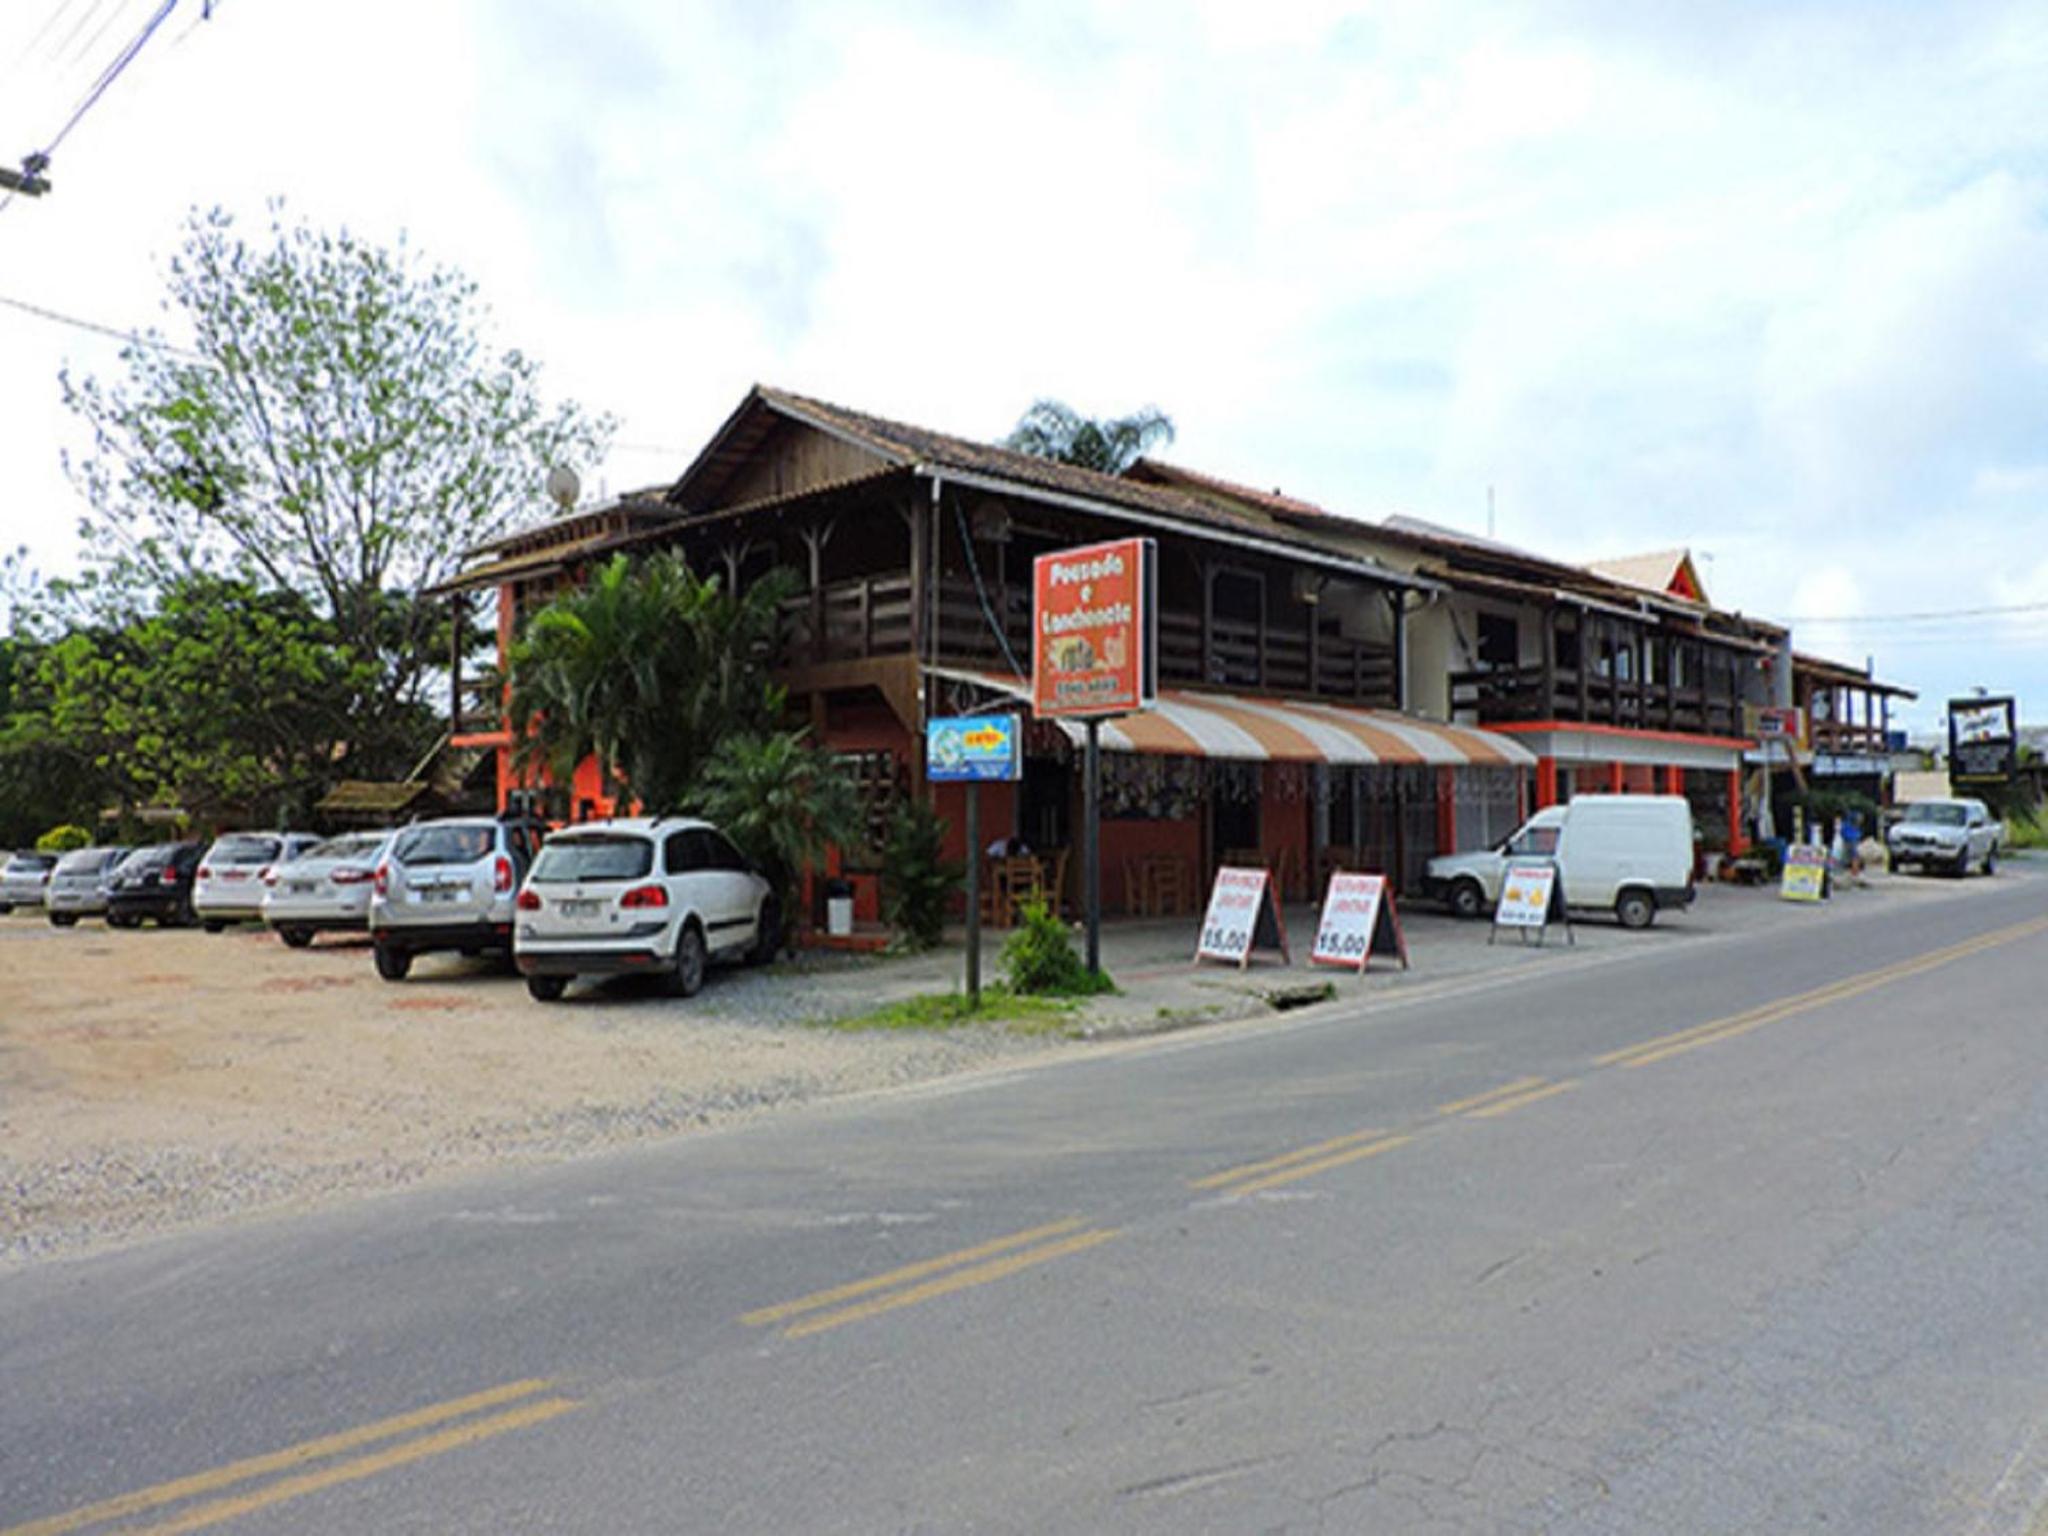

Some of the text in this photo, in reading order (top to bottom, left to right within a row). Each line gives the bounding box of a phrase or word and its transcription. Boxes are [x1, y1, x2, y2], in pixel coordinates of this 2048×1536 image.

[1050, 553, 1124, 586] Pousada
[1204, 928, 1246, 952] 15,00
[1319, 931, 1367, 957] 15,00
